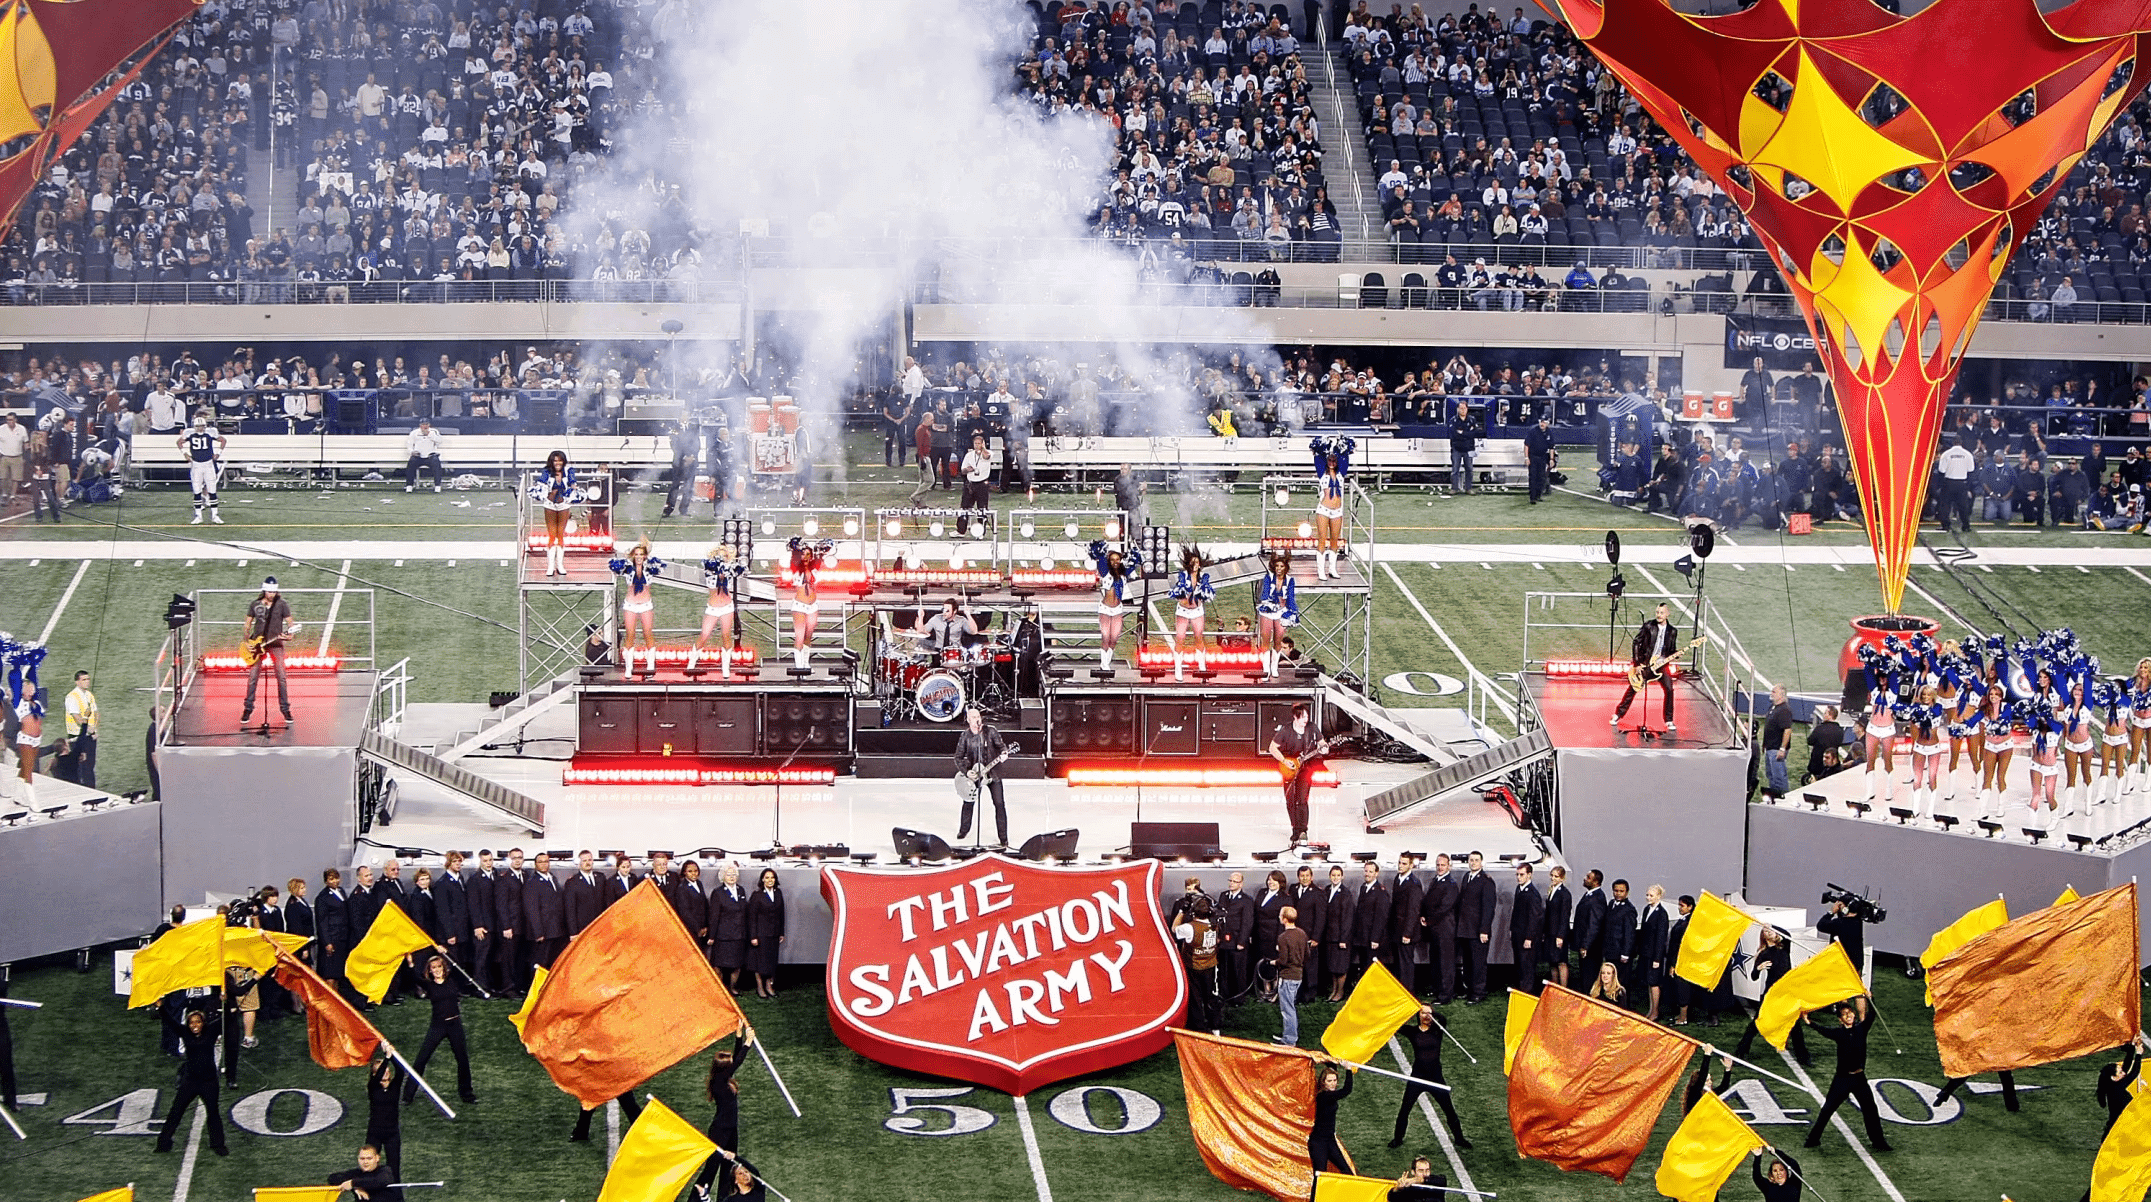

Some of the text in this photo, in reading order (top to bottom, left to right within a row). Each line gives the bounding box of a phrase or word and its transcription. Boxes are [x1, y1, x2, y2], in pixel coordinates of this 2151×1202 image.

[1506, 87, 1518, 98] 19
[402, 101, 416, 113] 82
[275, 112, 292, 126] 94
[1164, 211, 1180, 228] 54
[626, 269, 641, 281] 82
[1737, 335, 1773, 348] NFL
[1573, 402, 1587, 416] 31
[1688, 400, 1698, 410] G
[1718, 400, 1728, 411] G
[191, 436, 209, 450] 91
[887, 871, 1016, 944] THE
[849, 879, 1135, 1018] SALVATION
[967, 940, 1134, 1043] ARMY
